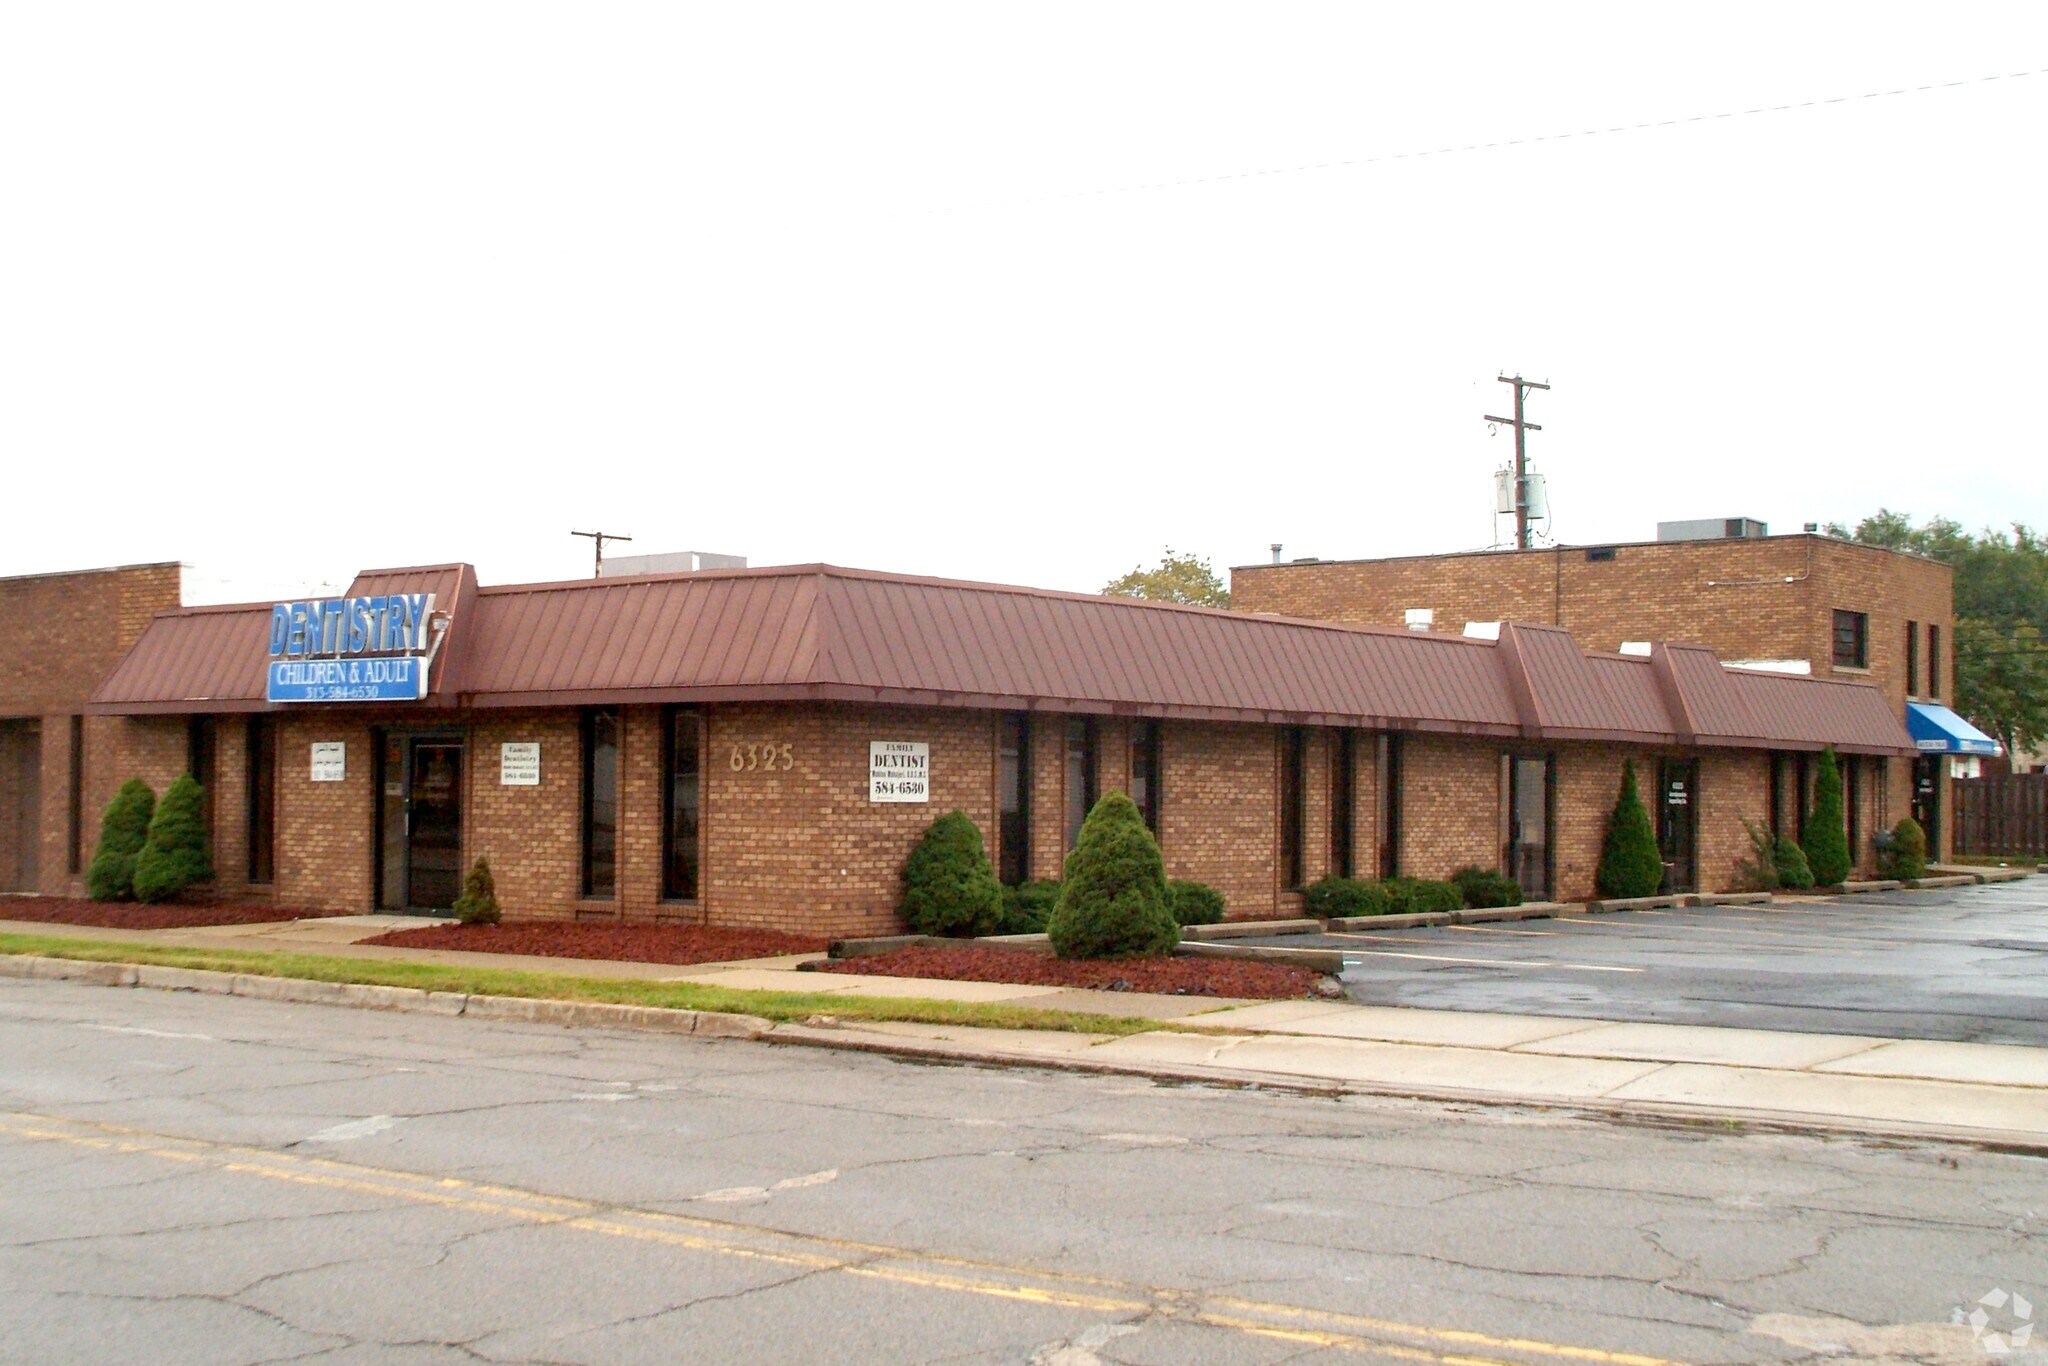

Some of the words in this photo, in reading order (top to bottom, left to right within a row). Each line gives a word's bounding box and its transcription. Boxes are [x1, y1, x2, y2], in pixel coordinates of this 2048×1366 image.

[270, 594, 432, 656] DENTISTRY
[277, 661, 346, 685] CHILDREN
[349, 662, 360, 683] &
[364, 661, 411, 683] ADULT
[730, 743, 794, 772] 6325
[874, 754, 925, 768] DENTIST
[875, 781, 924, 794] 584-6530
